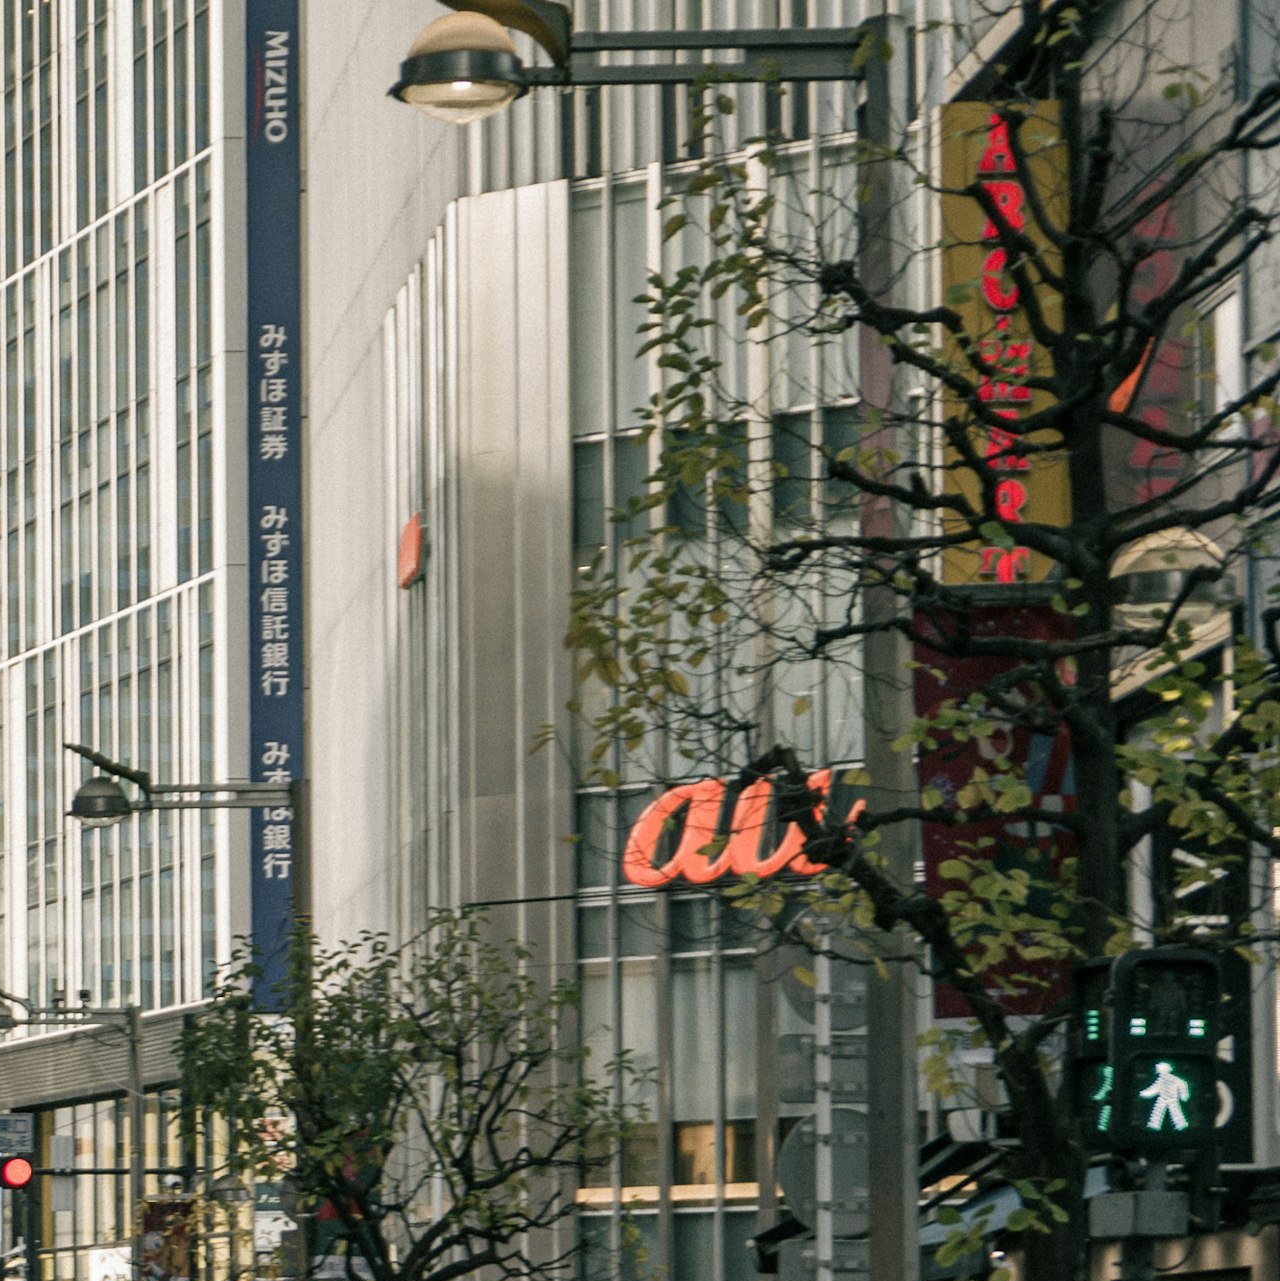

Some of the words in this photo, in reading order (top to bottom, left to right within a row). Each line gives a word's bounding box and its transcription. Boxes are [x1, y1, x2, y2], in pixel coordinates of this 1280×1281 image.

[263, 29, 290, 143] MIZUHO
[260, 324, 289, 460] みずほ証券
[260, 505, 289, 697] みずほ信託銀行
